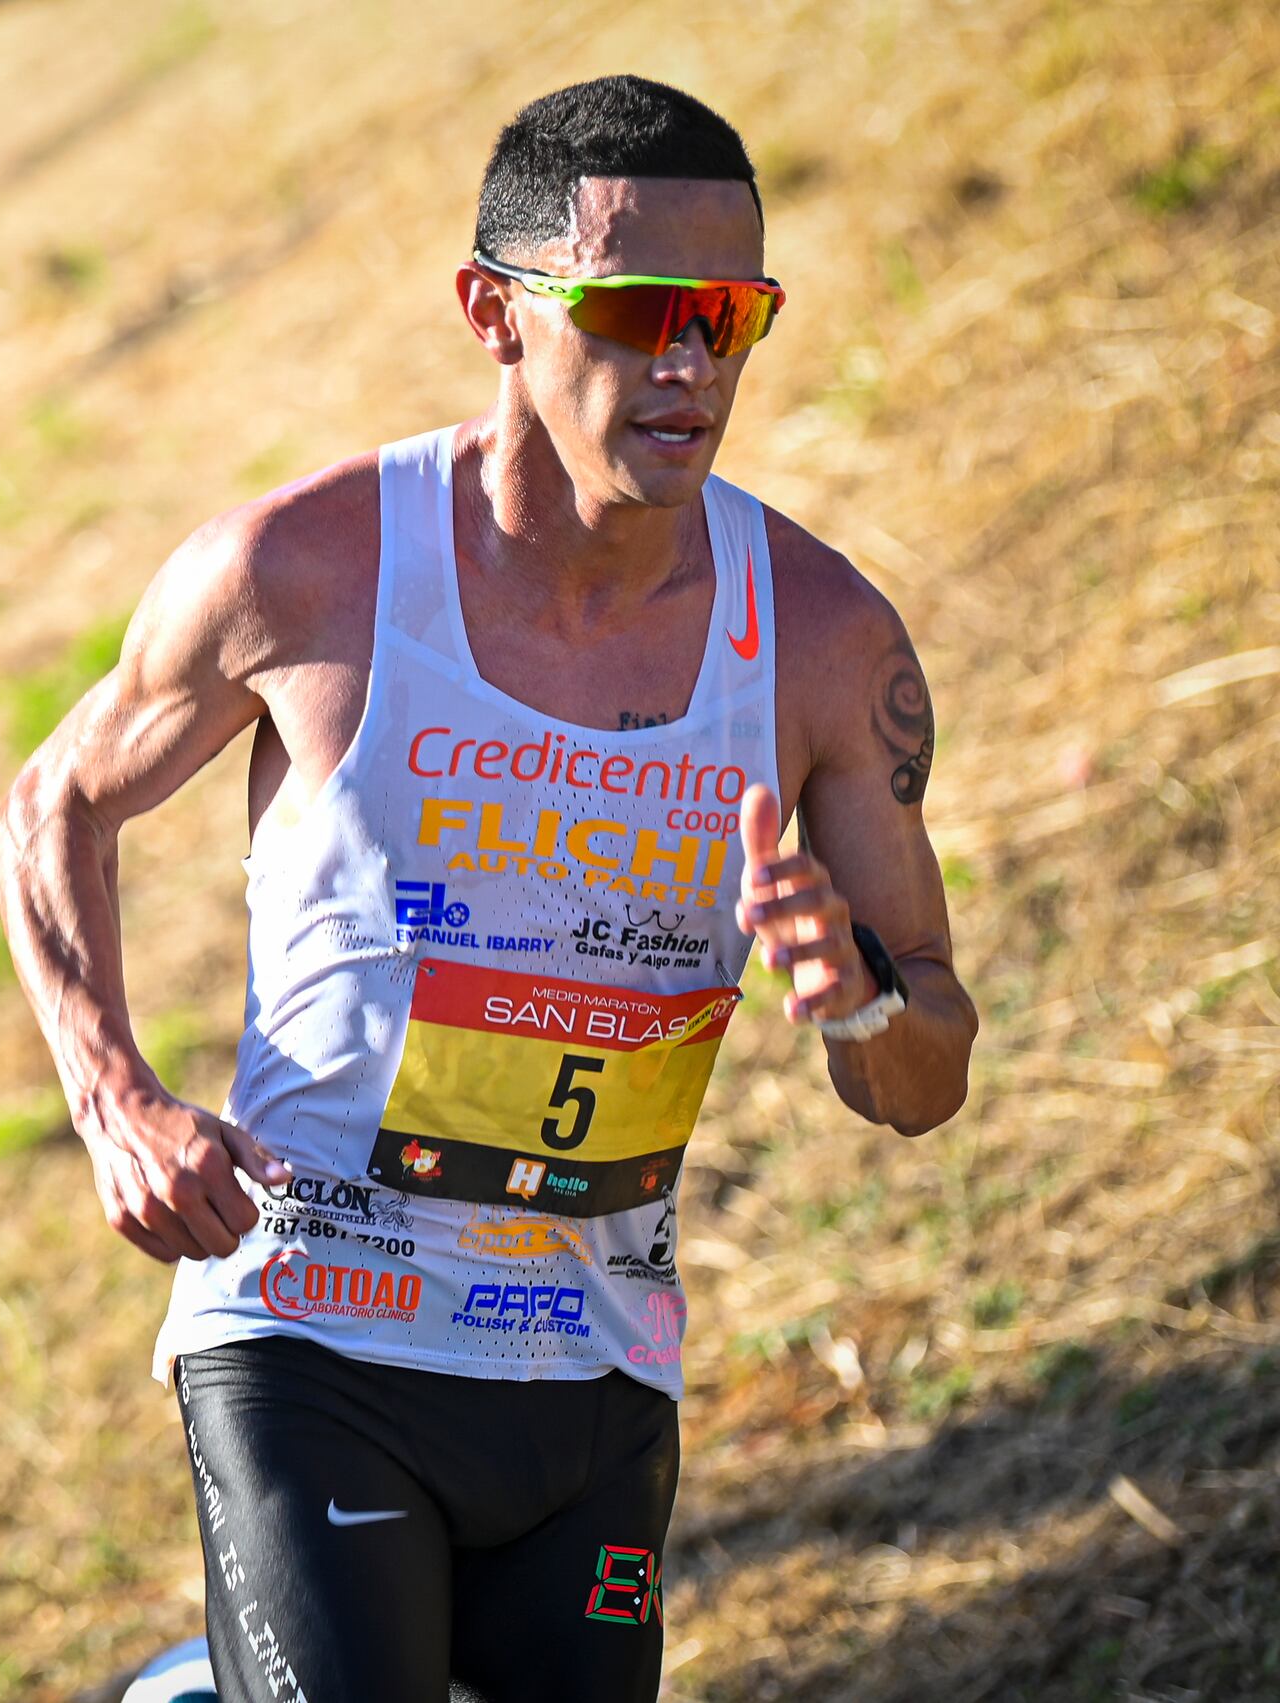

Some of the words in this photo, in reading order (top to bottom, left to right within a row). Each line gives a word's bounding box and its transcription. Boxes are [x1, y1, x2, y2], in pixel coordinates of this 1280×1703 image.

[408, 727, 745, 804] Credicentro
[418, 798, 728, 887] FLICHI
[667, 809, 740, 840] coop
[447, 852, 568, 880] AUTO
[584, 870, 717, 908] PARTS
[486, 935, 556, 953] IBARRY
[572, 918, 611, 941] JC
[620, 926, 709, 955] Fashion
[575, 941, 624, 961] Gafas
[628, 952, 639, 965] y
[640, 954, 670, 970] Algo
[674, 958, 701, 969] mas
[484, 996, 577, 1033] SAN
[586, 1012, 688, 1042] BLAS
[532, 986, 581, 1004] MEDIO
[583, 995, 661, 1015] MARATÓN
[541, 1053, 605, 1151] 5
[547, 1173, 589, 1192] hello
[305, 1302, 375, 1319] LABORATORIO
[375, 1308, 415, 1323] CLINICO
[464, 1284, 584, 1321] PAPO
[452, 1312, 516, 1331] POLISH
[518, 1320, 529, 1332] &
[535, 1319, 590, 1338] CUSTOM
[188, 1420, 225, 1534] HUMAN
[219, 1539, 245, 1591] IS
